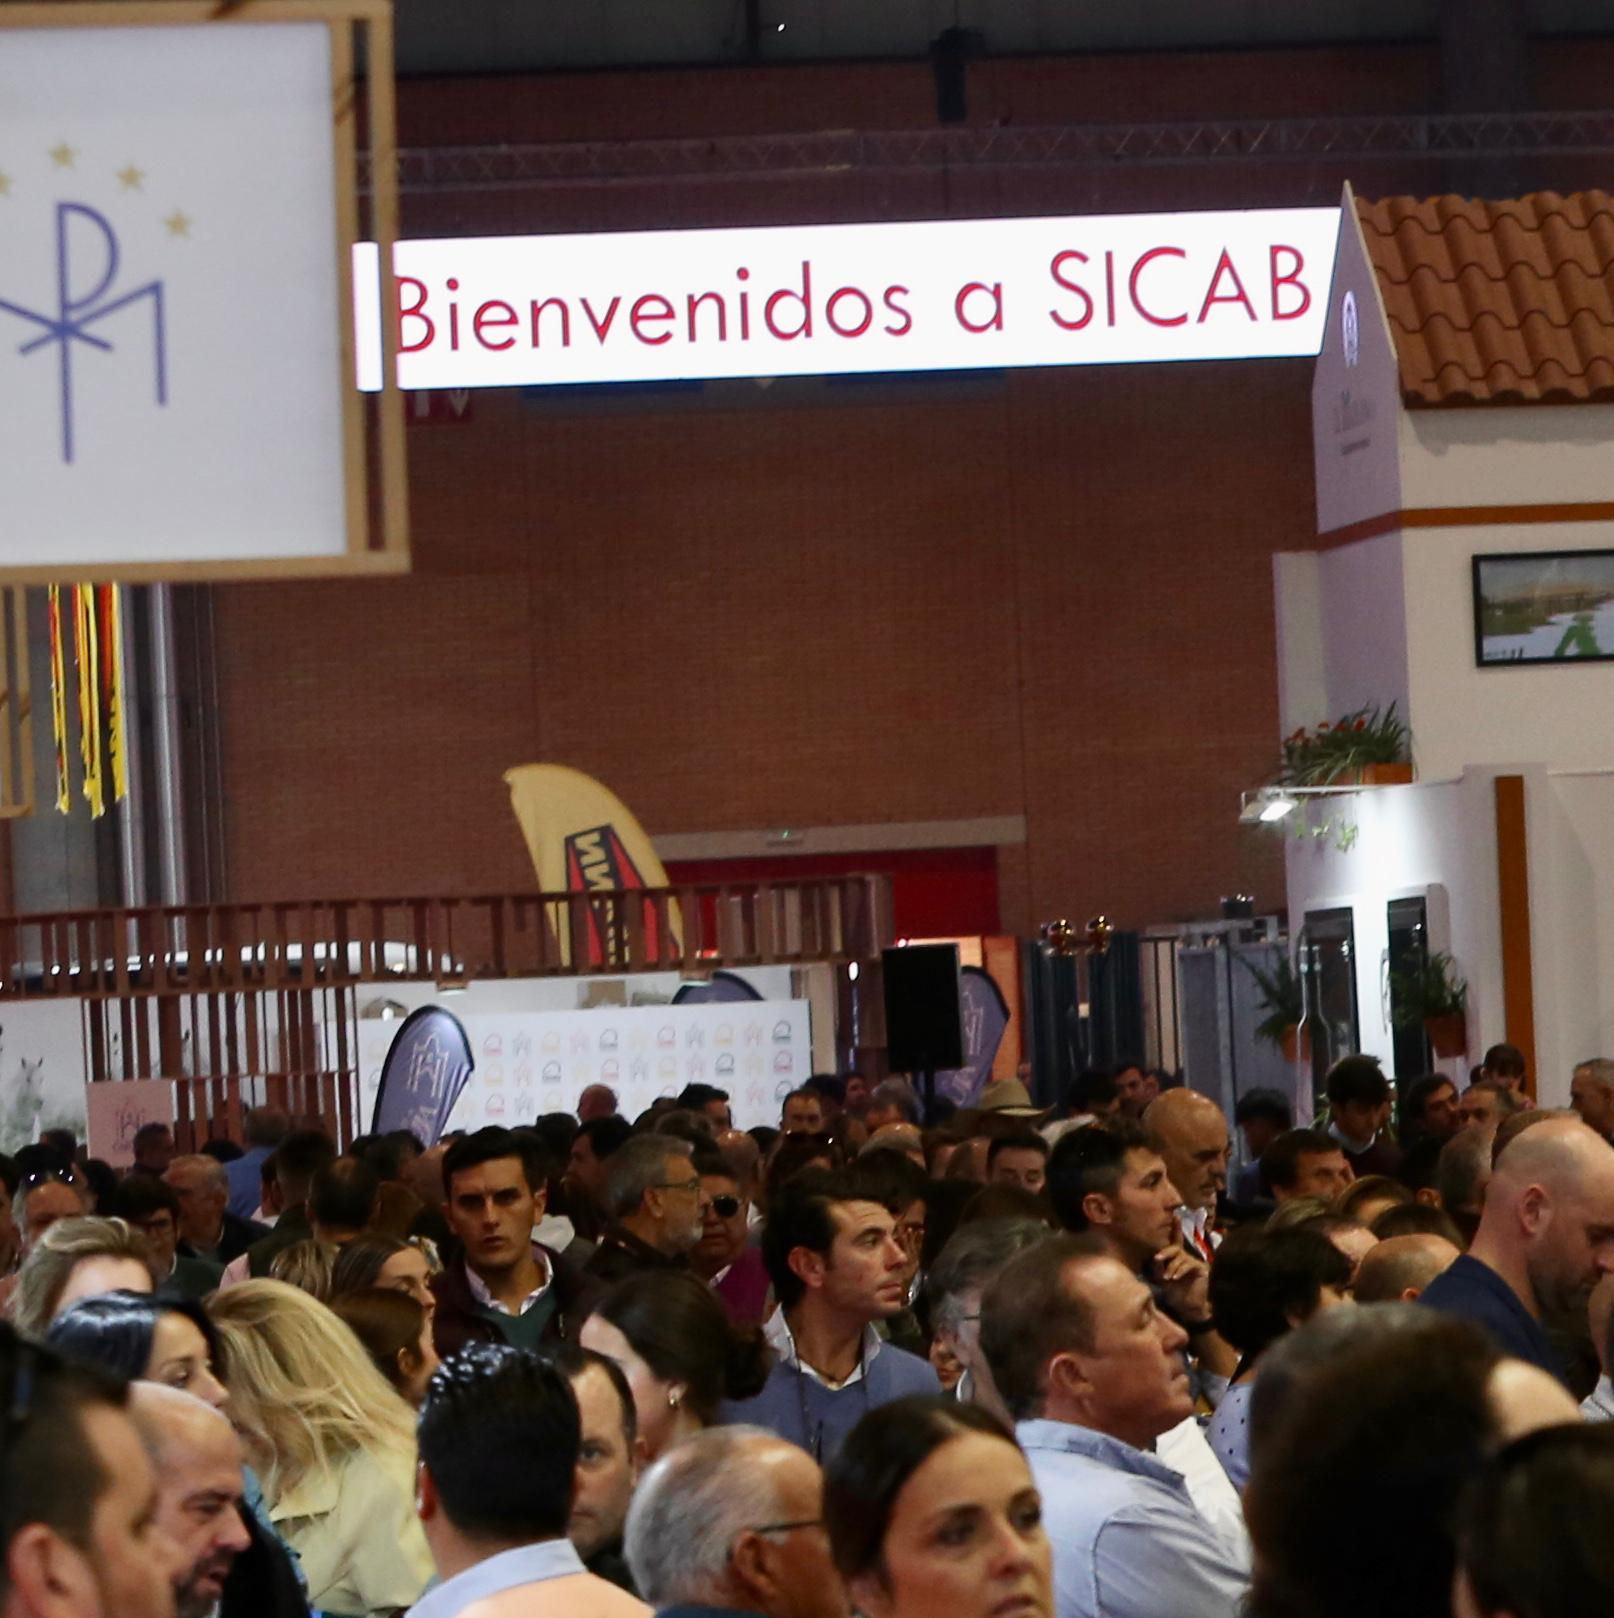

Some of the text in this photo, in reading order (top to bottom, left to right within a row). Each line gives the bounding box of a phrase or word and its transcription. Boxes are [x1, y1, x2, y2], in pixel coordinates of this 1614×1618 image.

[392, 244, 1312, 355] Bienvenidos a SICAB
